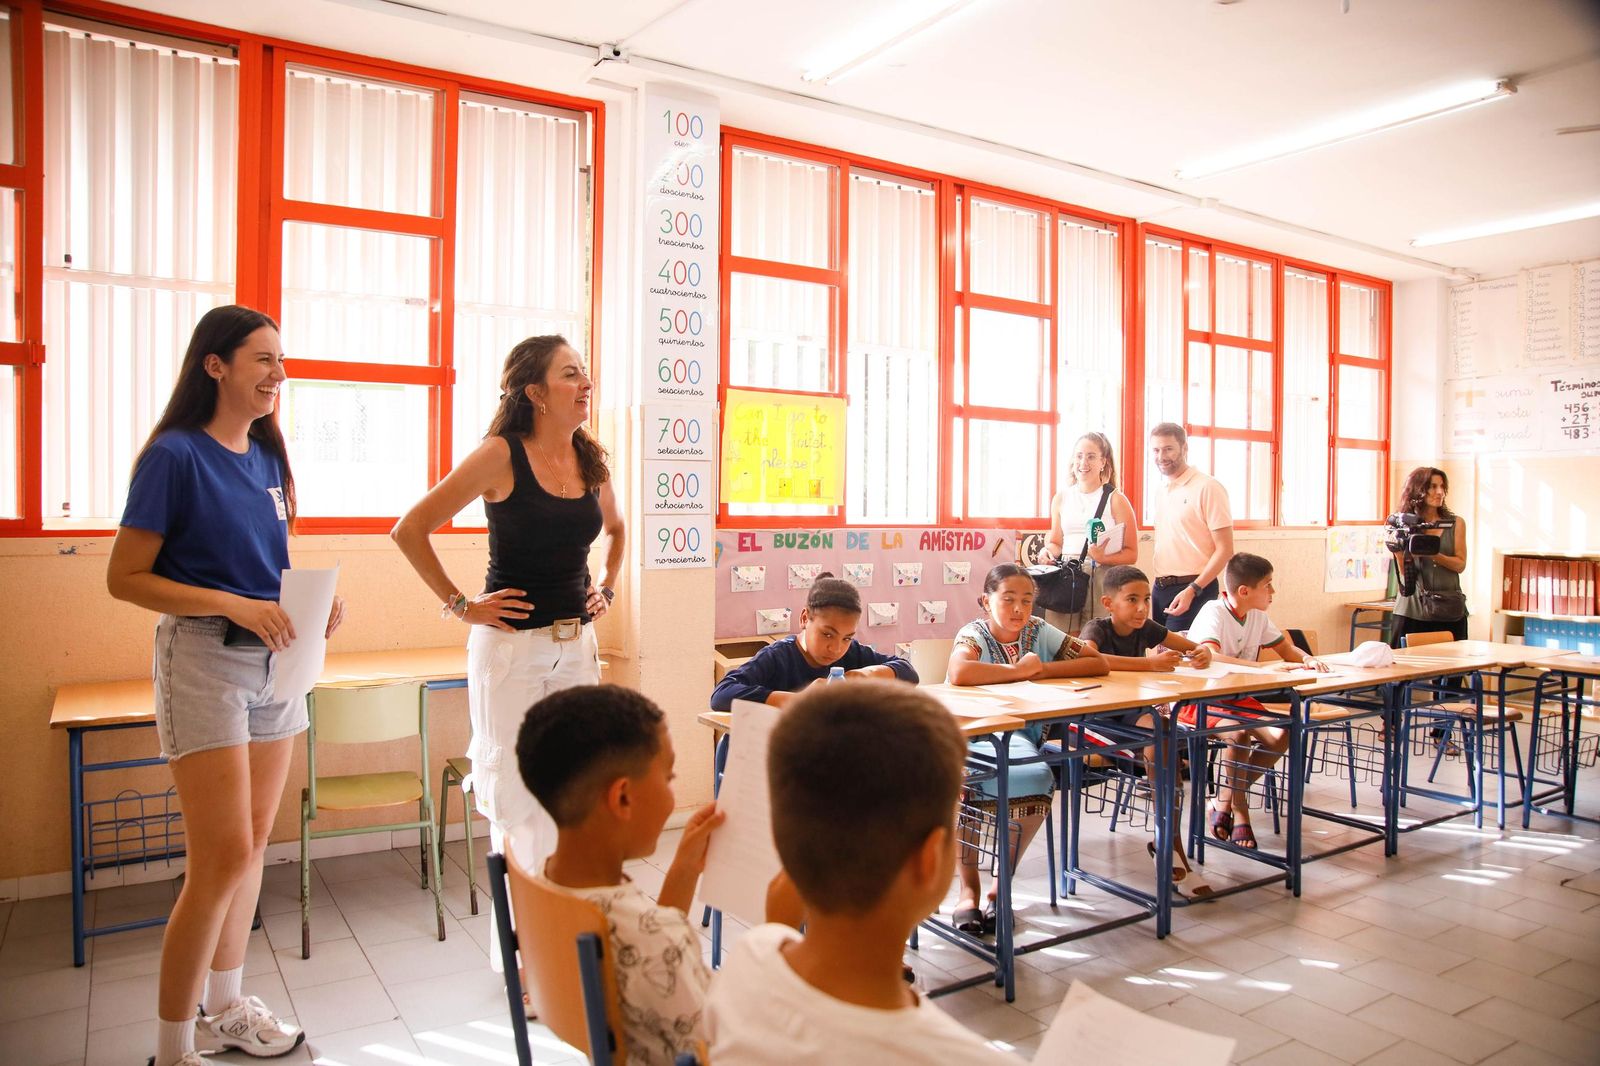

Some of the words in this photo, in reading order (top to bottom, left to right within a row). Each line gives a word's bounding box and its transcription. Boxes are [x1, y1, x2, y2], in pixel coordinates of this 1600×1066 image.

[663, 109, 703, 139] 100
[659, 185, 705, 201] doscientos
[660, 209, 703, 238] 300
[658, 237, 705, 250] trescientos
[658, 259, 701, 287] 400
[649, 287, 708, 300] cuatrocientos
[660, 308, 702, 335] 500
[658, 337, 705, 348] quinientos
[658, 358, 701, 384] 600
[658, 387, 704, 397] seiscientos
[814, 404, 828, 424] to
[1564, 402, 1590, 413] 456
[1572, 413, 1590, 424] 27
[658, 418, 700, 443] 700
[1564, 428, 1590, 439] 483
[657, 447, 704, 456] setecientos
[657, 473, 699, 498] 800
[655, 500, 704, 510] ochocientos
[658, 527, 700, 553] 900
[738, 532, 762, 552] EL
[773, 530, 833, 550] BUZÓN
[846, 532, 870, 550] DE
[881, 532, 904, 549] LA
[654, 556, 706, 564] novecientos
